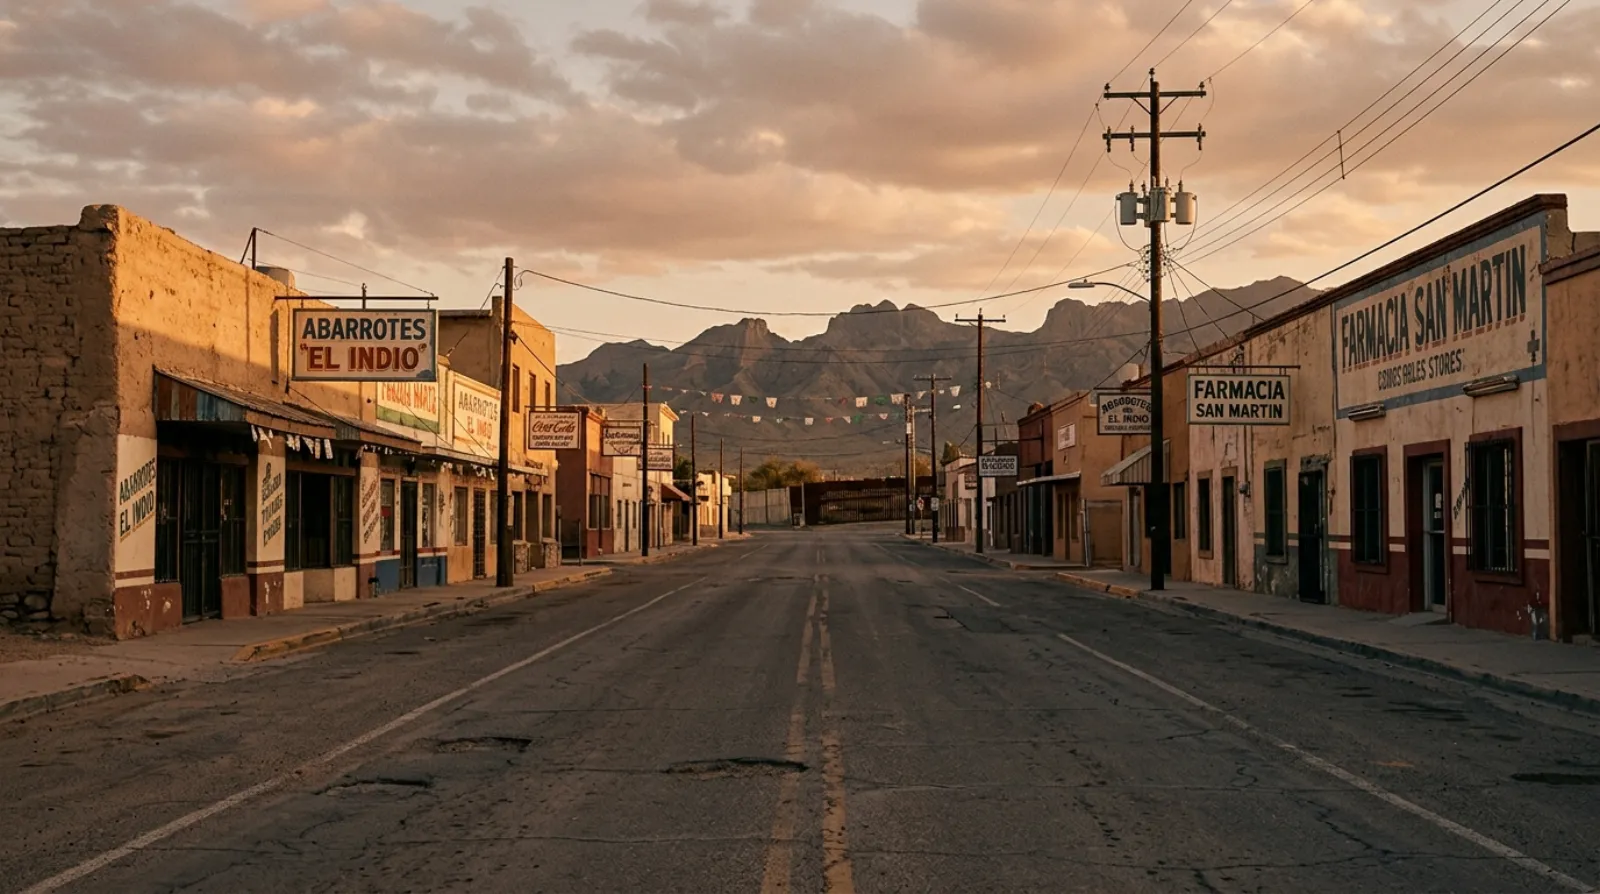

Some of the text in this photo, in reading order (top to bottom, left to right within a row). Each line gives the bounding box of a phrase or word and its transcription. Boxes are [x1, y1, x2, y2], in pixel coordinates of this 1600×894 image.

[1341, 245, 1527, 370] FARMACIA SAN MARTIN
[302, 318, 426, 341] ABARROTES
[1194, 380, 1285, 400] FARMACIA
[1196, 403, 1283, 418] SAN MARTIN
[120, 509, 131, 537] EL
